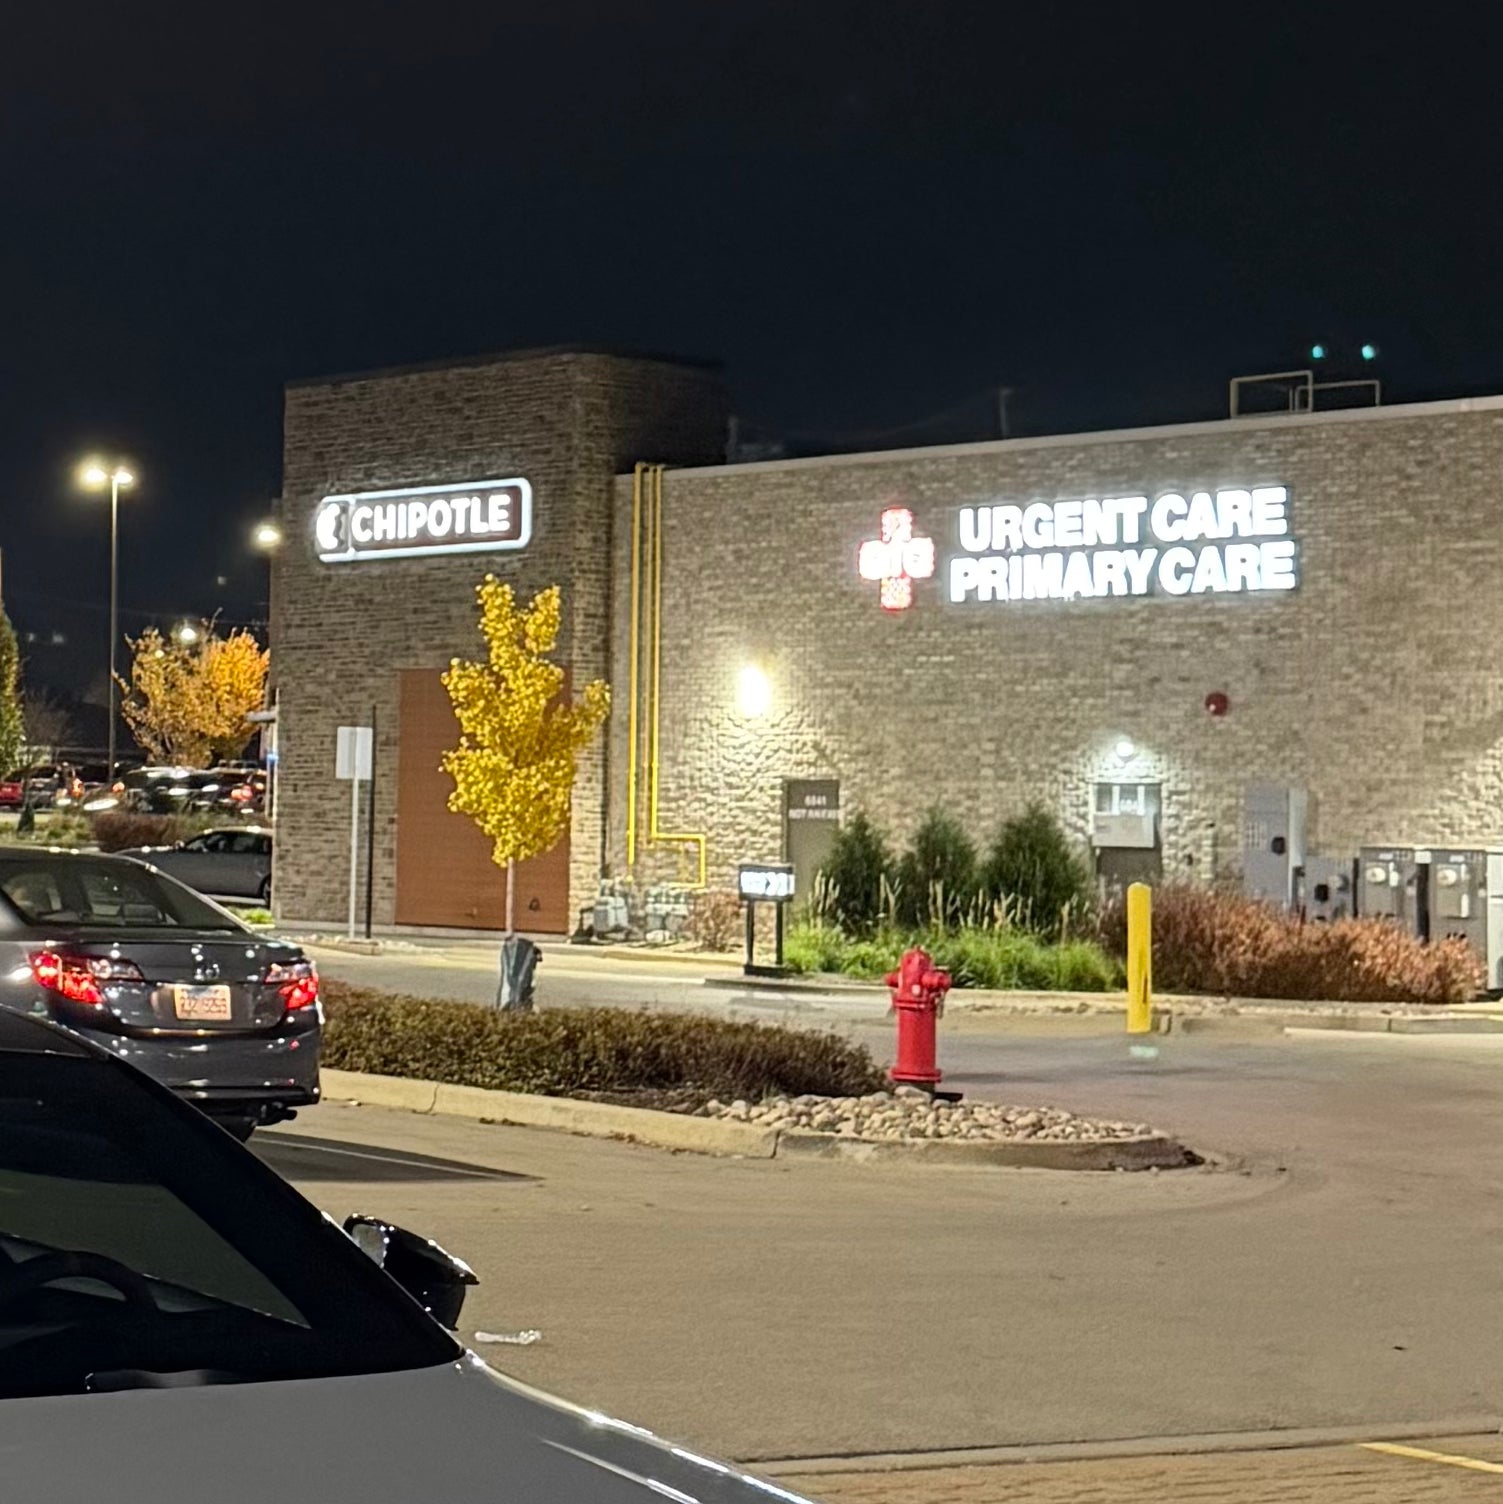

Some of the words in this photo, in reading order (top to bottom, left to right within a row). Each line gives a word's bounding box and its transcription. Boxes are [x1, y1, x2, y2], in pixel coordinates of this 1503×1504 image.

[351, 494, 511, 542] CHIPOTLE
[959, 497, 1147, 551] URGENT
[1150, 487, 1287, 541] CARE
[950, 547, 1158, 602] PRIMARY
[1159, 541, 1295, 595] CARE
